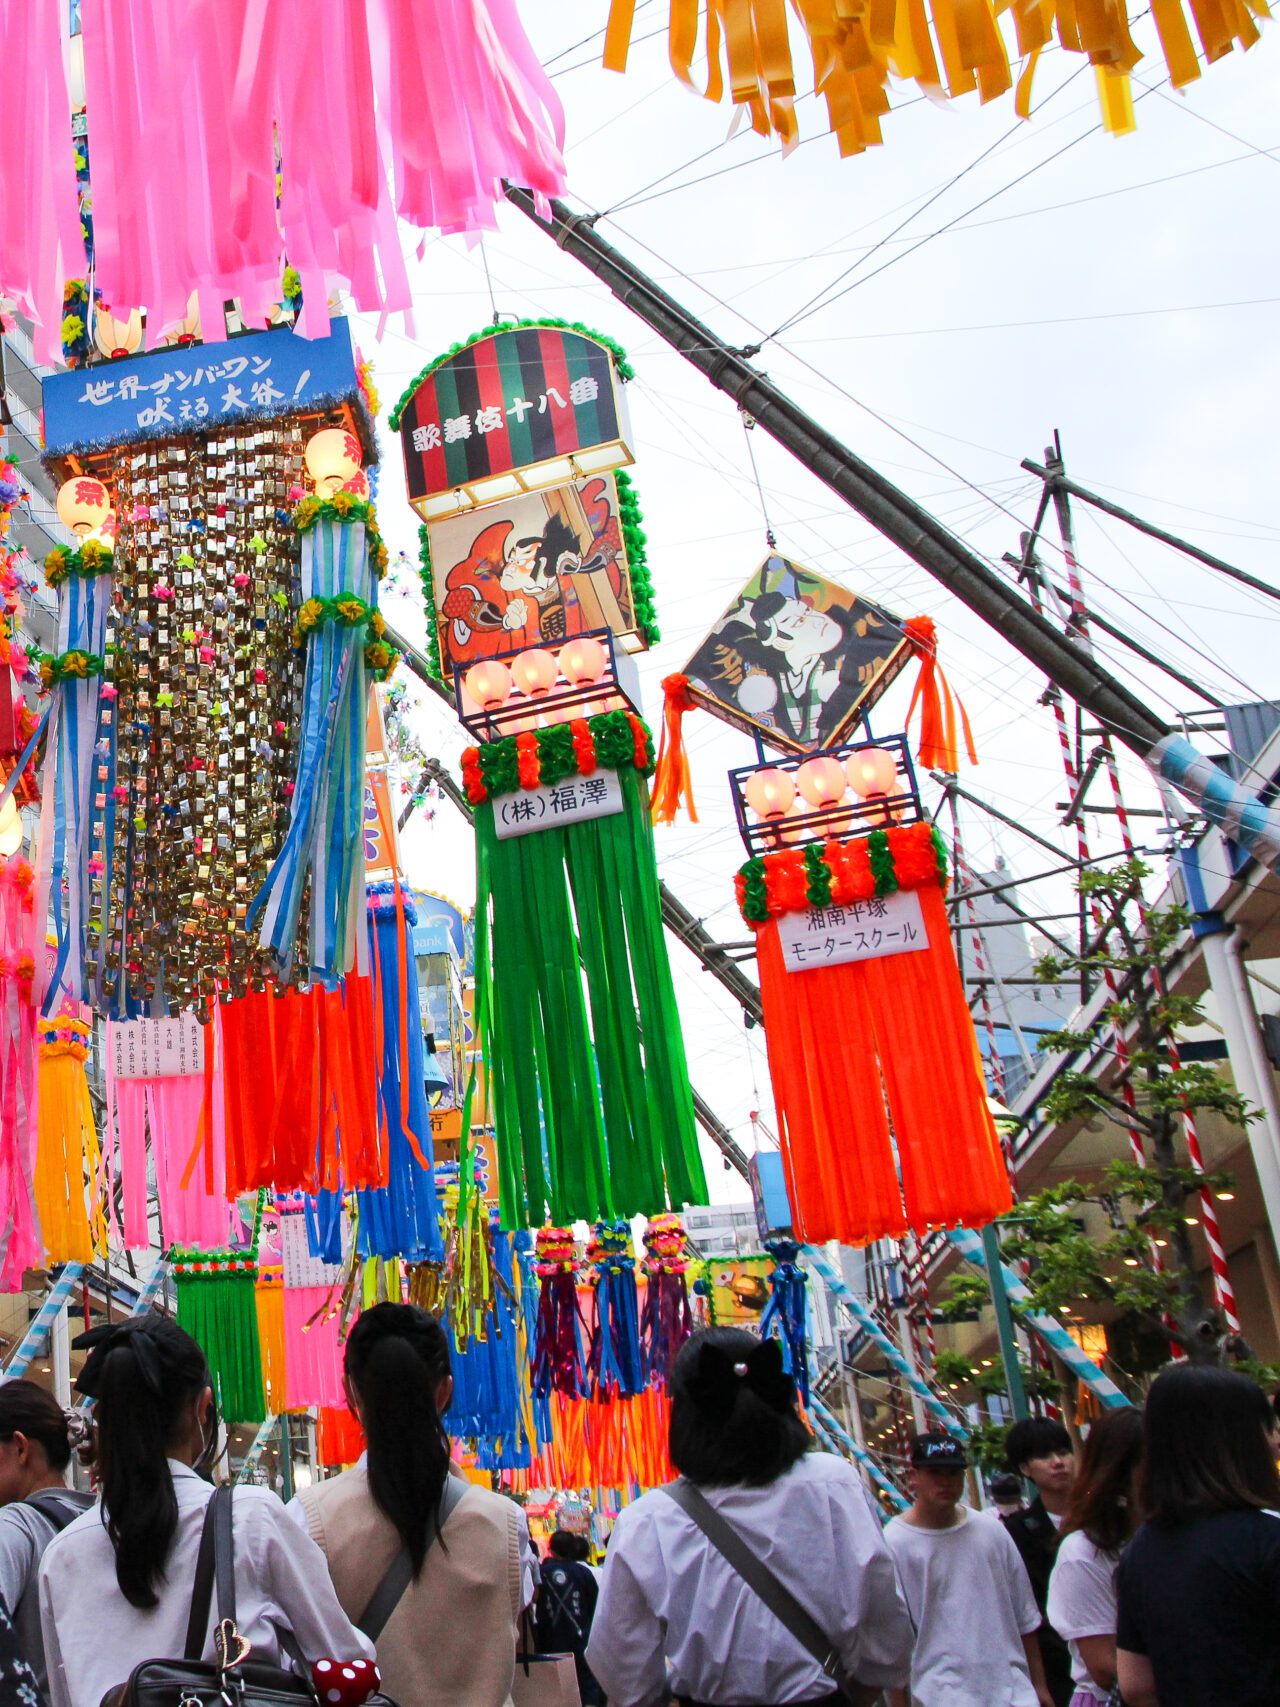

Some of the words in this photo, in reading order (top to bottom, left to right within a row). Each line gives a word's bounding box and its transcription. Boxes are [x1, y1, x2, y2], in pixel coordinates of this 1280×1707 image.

[78, 356, 272, 405] 世界ナンバーワン
[412, 376, 600, 452] 歌舞伎十八番
[74, 481, 104, 508] 祭
[501, 778, 608, 825] (株)福澤
[806, 897, 888, 932] 湘南平塚
[792, 922, 917, 961] モータースクール
[191, 1025, 199, 1069] 株式会社
